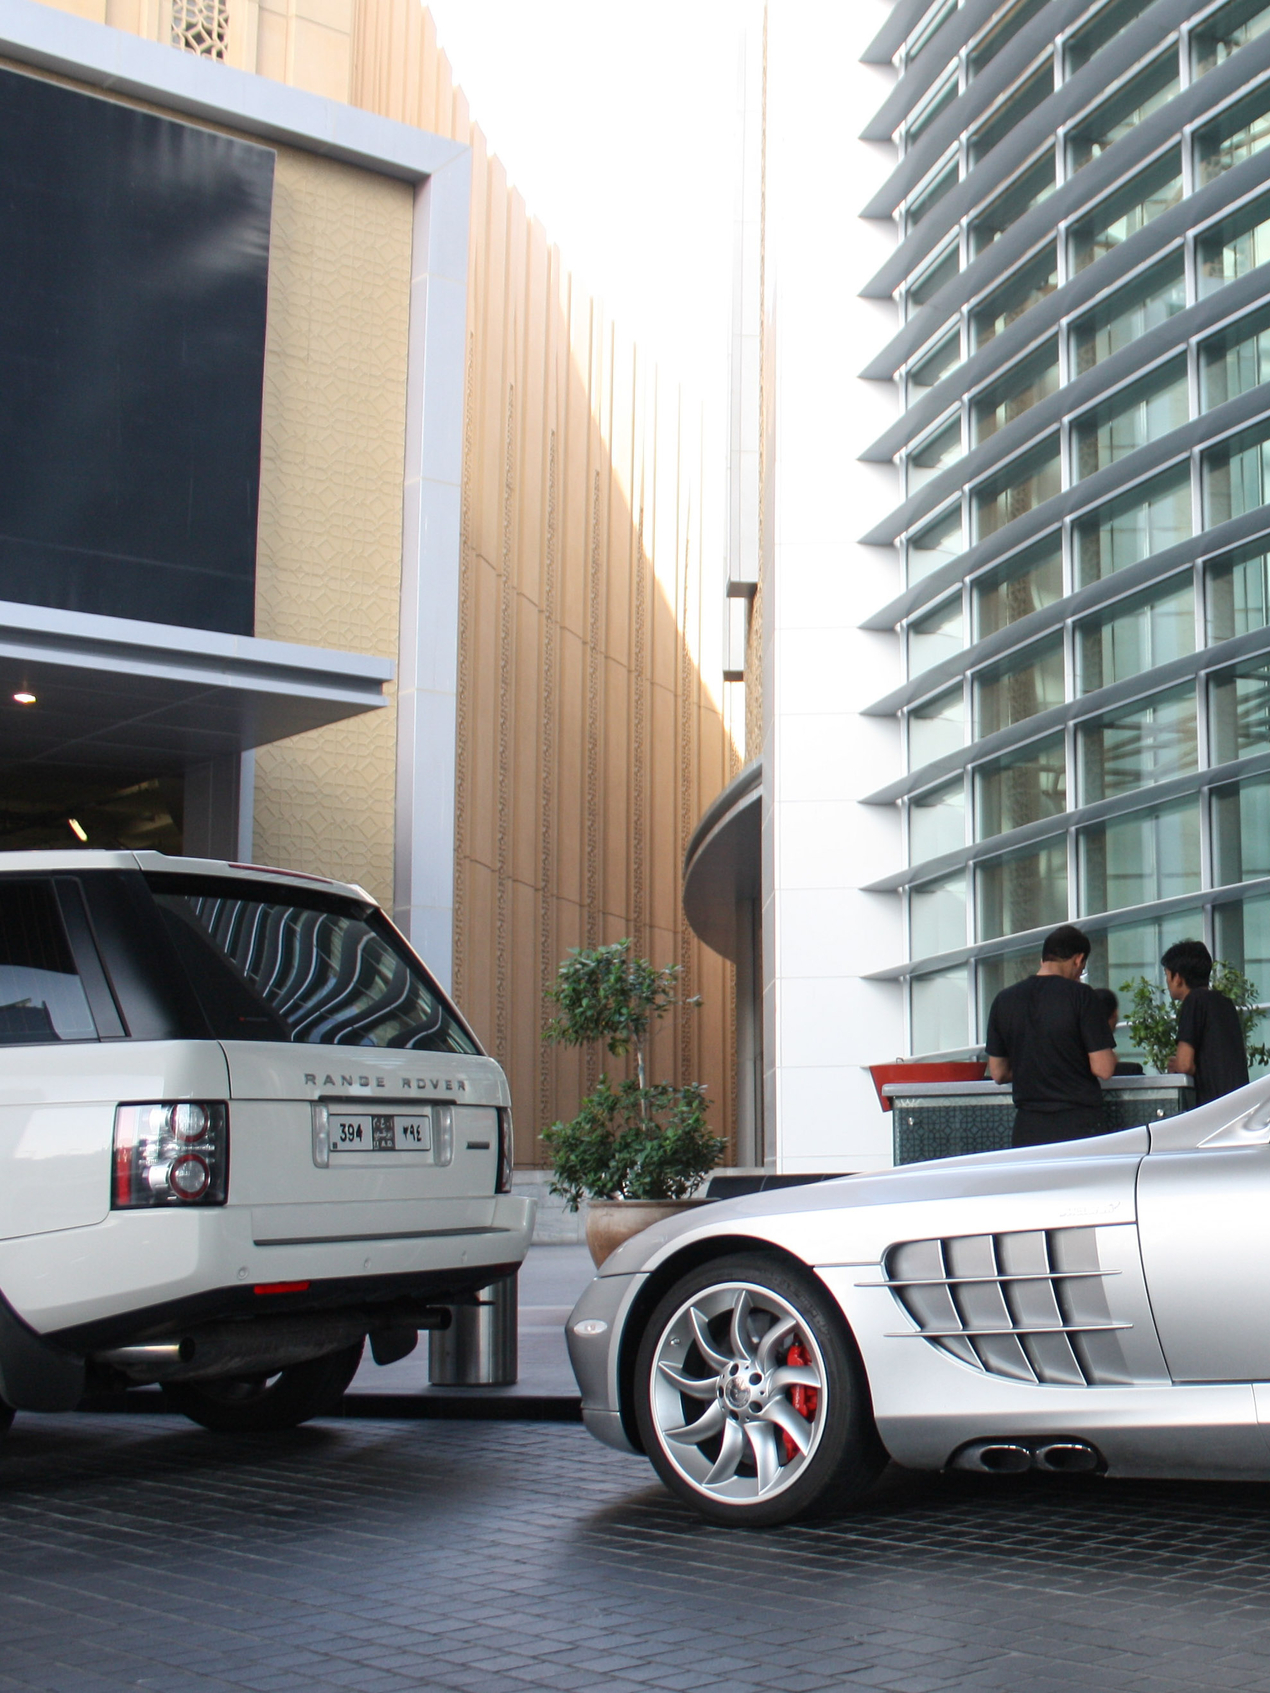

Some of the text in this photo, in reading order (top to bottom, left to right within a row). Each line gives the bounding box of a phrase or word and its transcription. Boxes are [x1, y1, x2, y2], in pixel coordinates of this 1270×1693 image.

[304, 1073, 466, 1091] RANGE ROVER
[340, 1123, 363, 1142] 394
